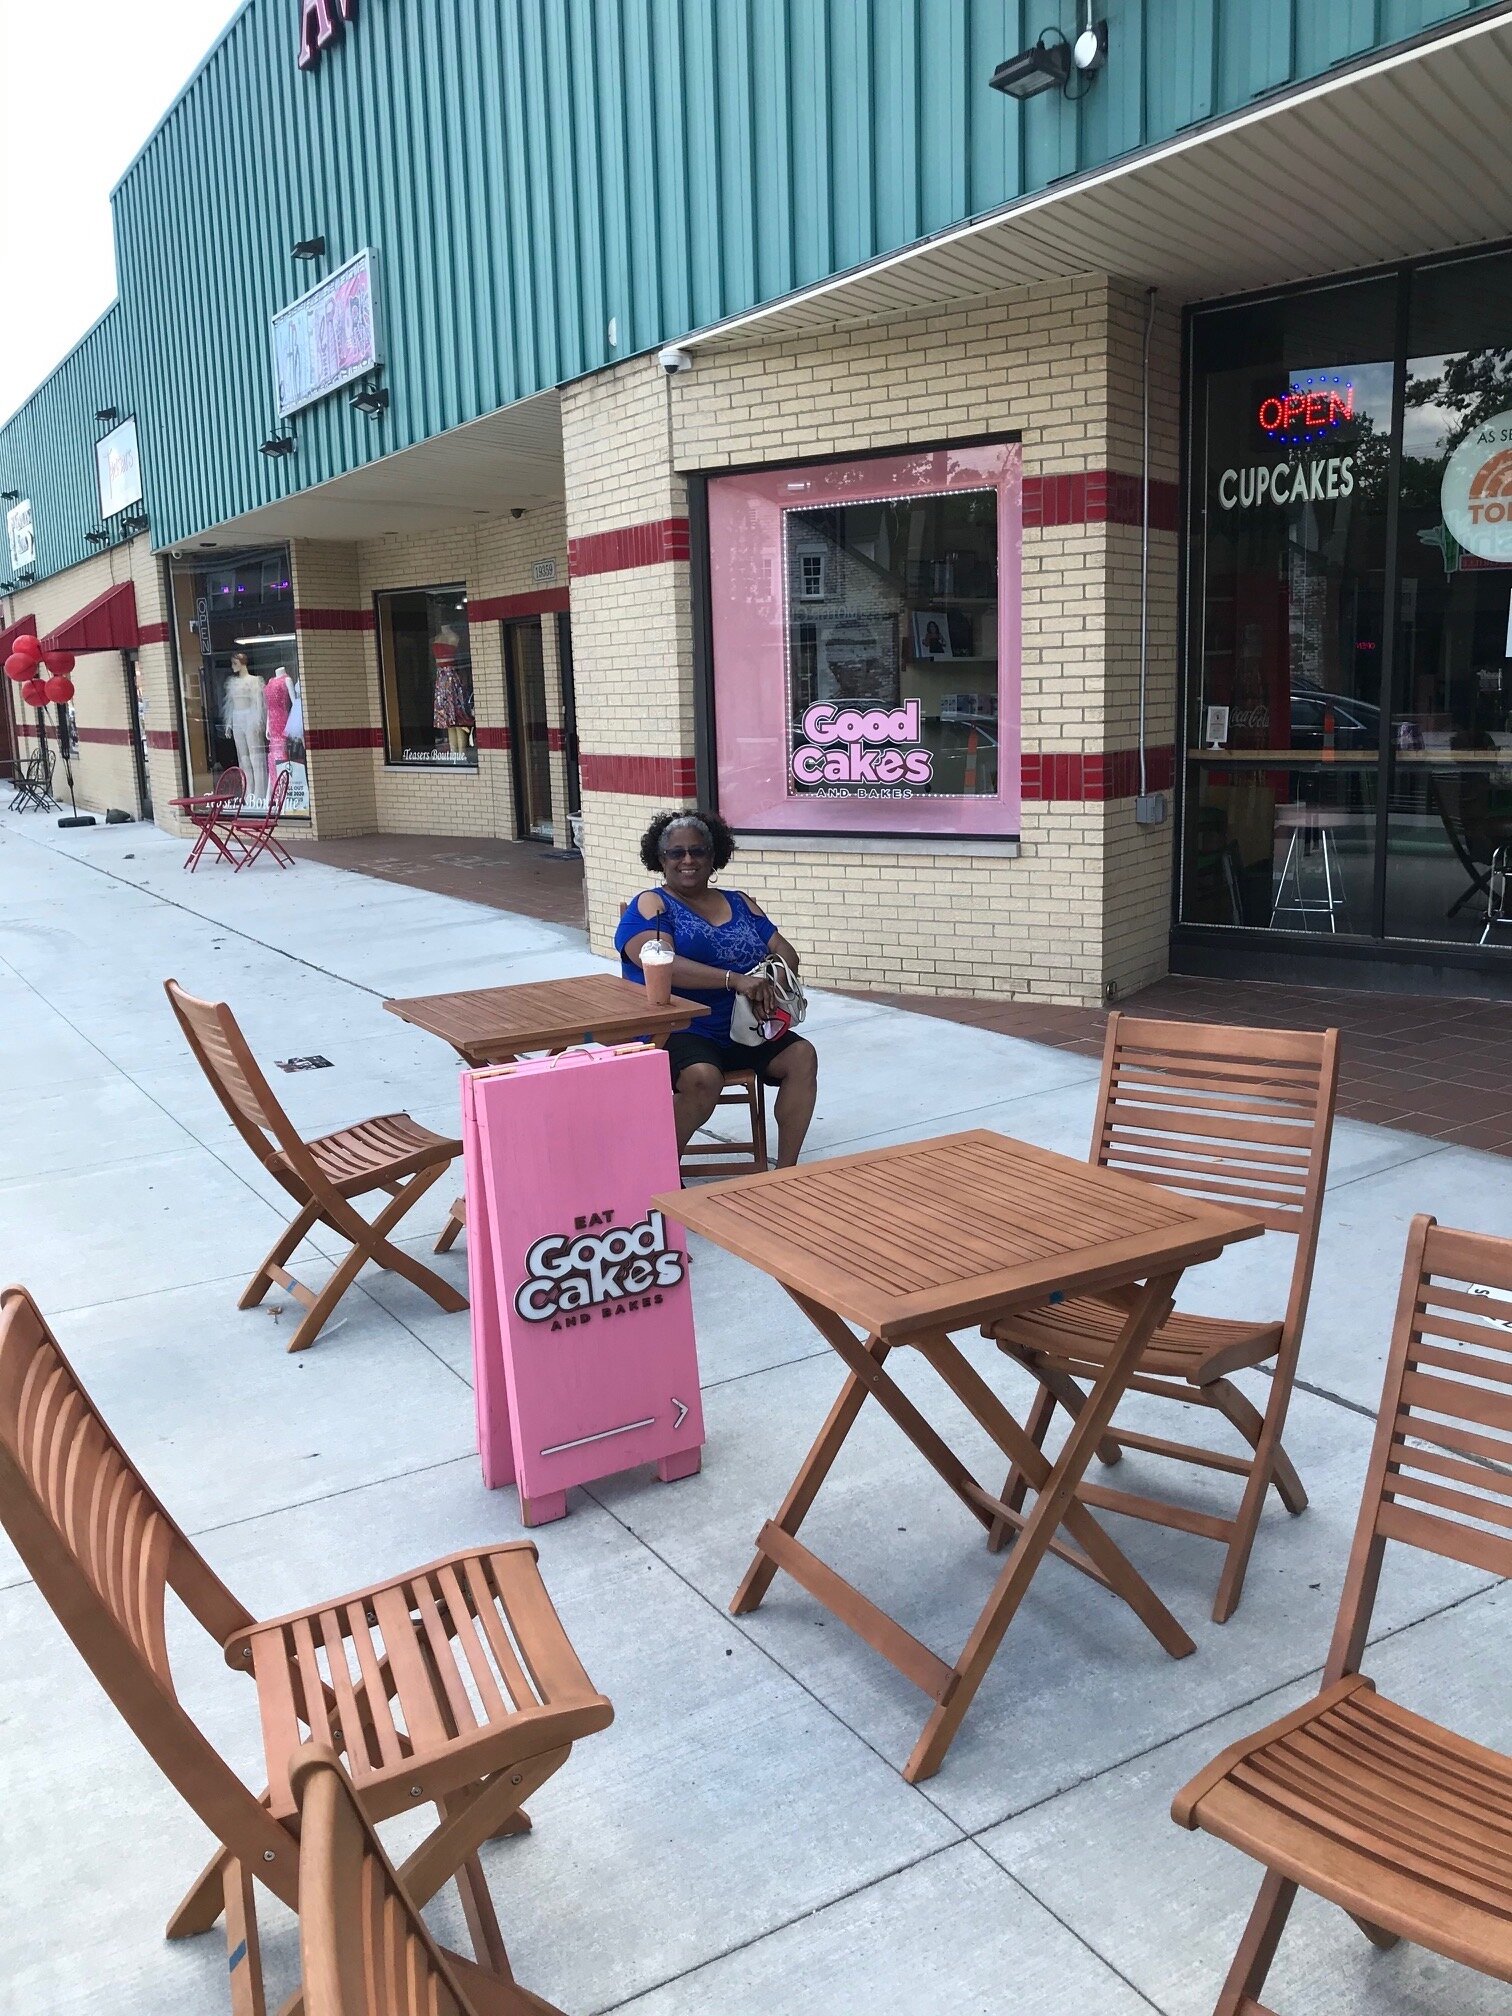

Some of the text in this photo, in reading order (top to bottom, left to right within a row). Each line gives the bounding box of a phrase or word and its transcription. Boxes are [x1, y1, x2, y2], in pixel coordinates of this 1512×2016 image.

[1259, 386, 1355, 431] OPEN
[1477, 430, 1496, 445] AS
[1218, 456, 1355, 511] CUPCAKES
[1468, 501, 1512, 525] TO
[196, 599, 211, 654] OPEN
[801, 698, 922, 746] Good
[402, 747, 430, 761] Teasers
[791, 742, 934, 786] Cakes
[817, 787, 914, 799] AND BAKES
[573, 1208, 615, 1231] EAT
[524, 1208, 668, 1282] Good
[513, 1250, 685, 1324] Cakes
[550, 1293, 665, 1332] AND BAKES
